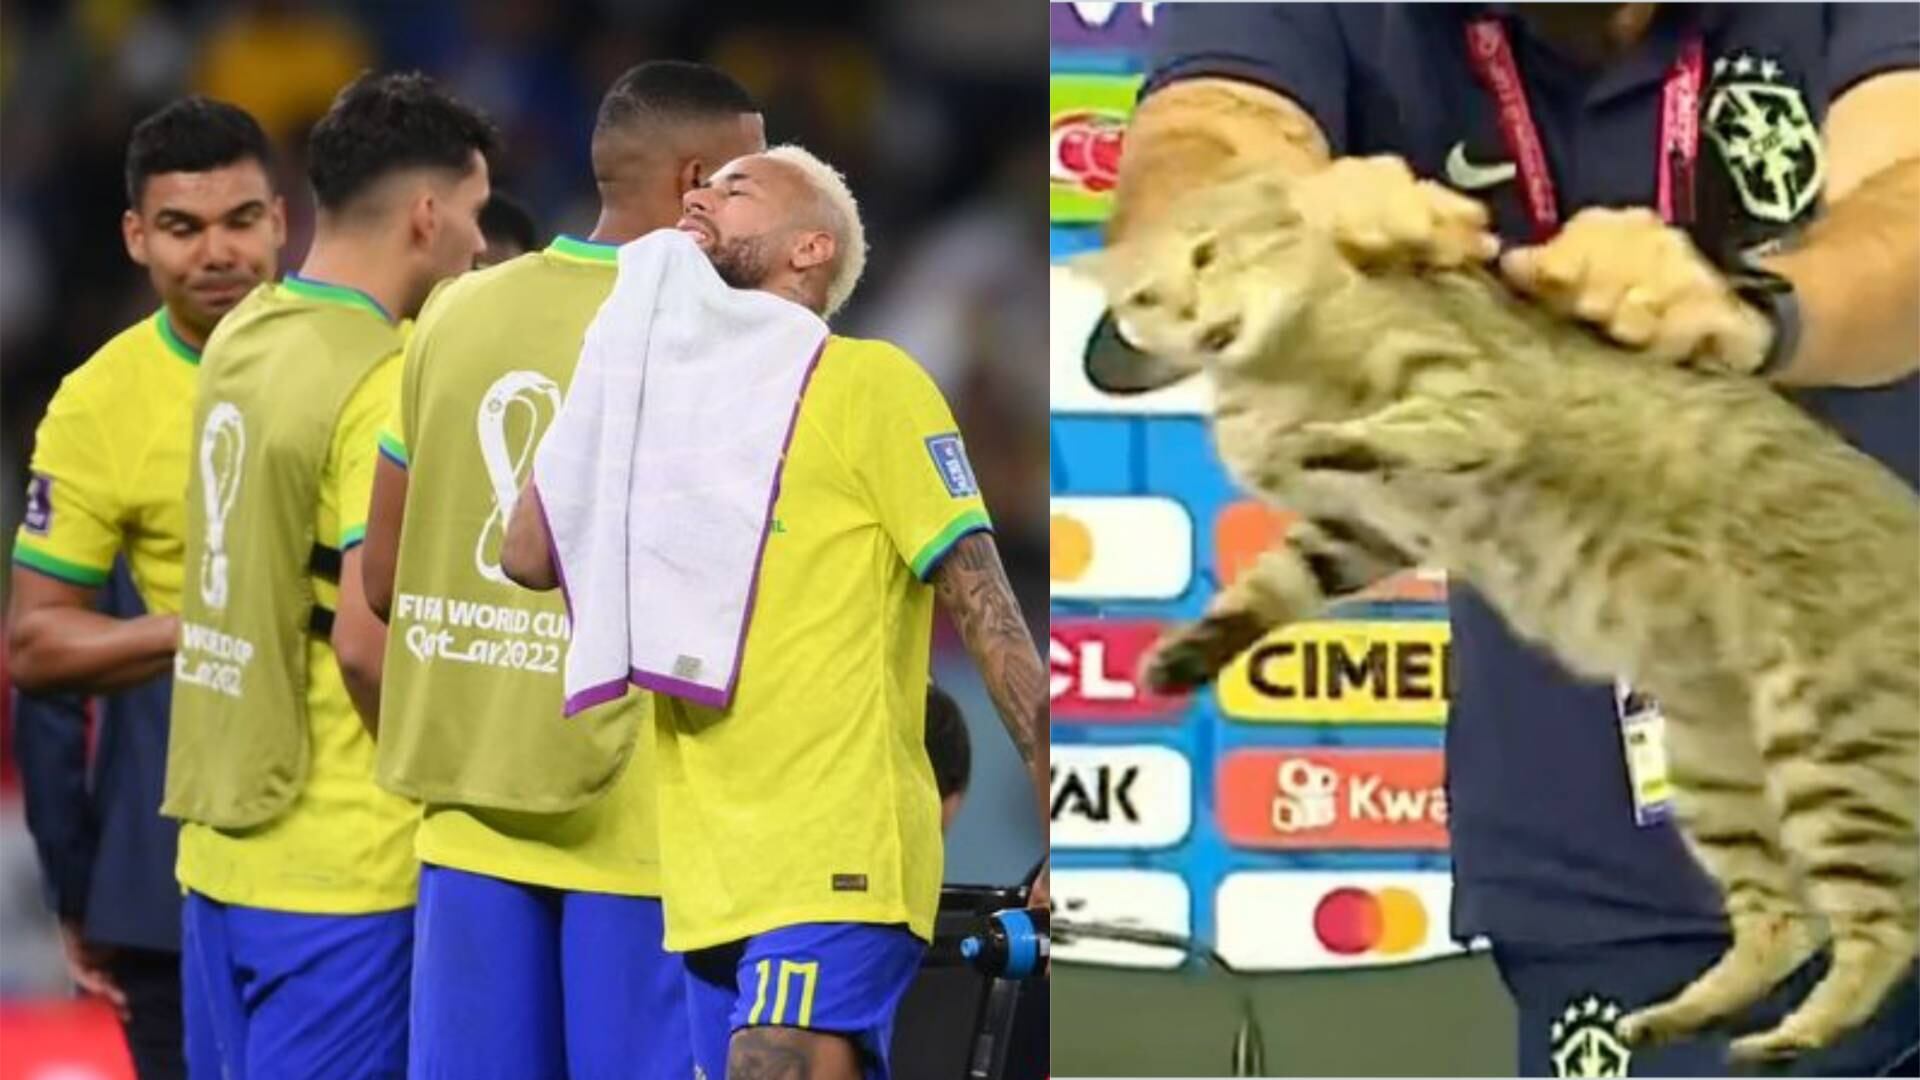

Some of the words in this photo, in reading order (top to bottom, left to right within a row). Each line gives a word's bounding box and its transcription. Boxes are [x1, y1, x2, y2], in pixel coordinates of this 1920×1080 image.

[397, 593, 443, 622] FIFA
[1247, 641, 1452, 700] CIME
[1050, 764, 1140, 822] AK
[748, 959, 819, 1026] 10
